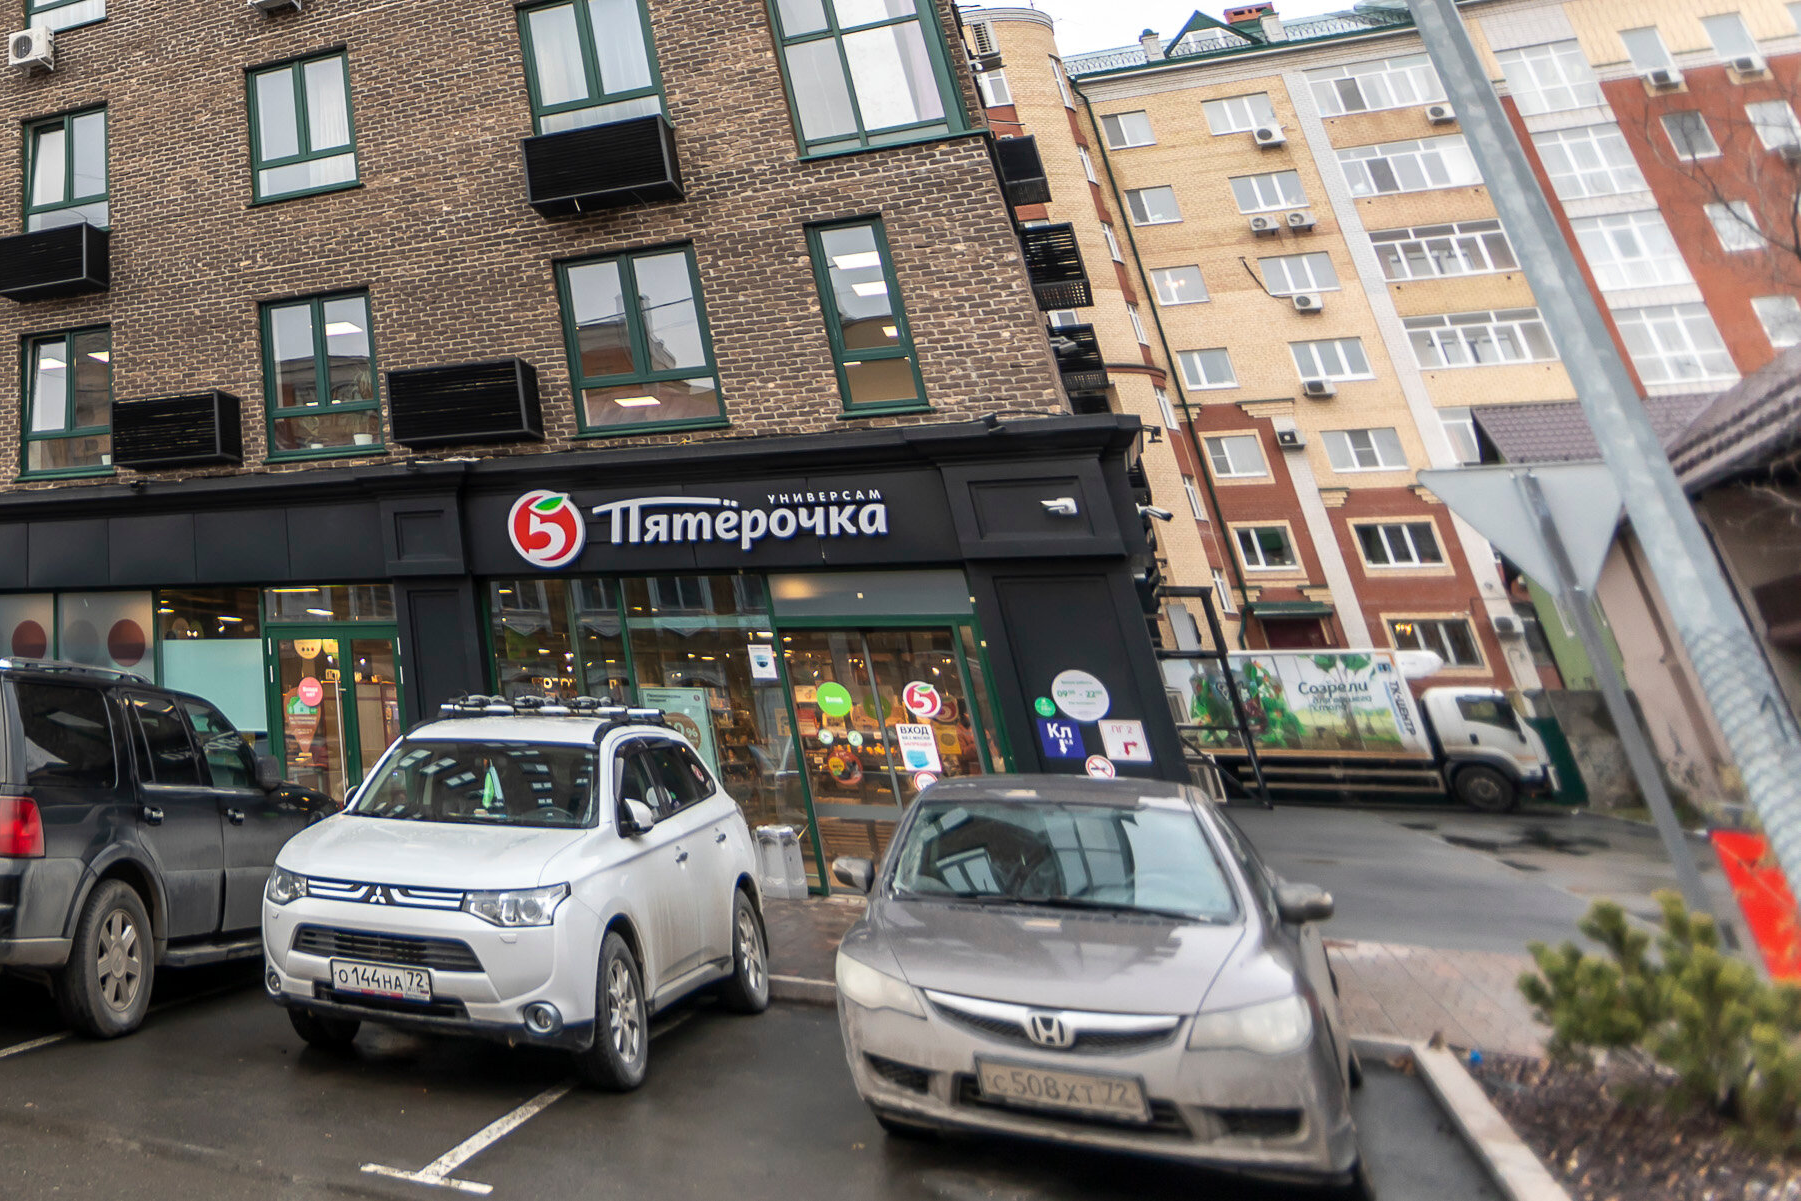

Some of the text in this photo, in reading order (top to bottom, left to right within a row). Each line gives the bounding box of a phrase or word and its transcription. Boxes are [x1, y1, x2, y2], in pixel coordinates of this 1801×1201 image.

[767, 489, 882, 504] УНИВЕРСАМ
[592, 496, 889, 551] Пятёрочка
[1299, 681, 1368, 698] Созрели
[1389, 680, 1416, 737] ТК-ЦЕНТР
[900, 726, 929, 735] ВХОД
[1046, 722, 1073, 739] Кл
[406, 971, 424, 988] 72
[1101, 1080, 1128, 1103] 72
